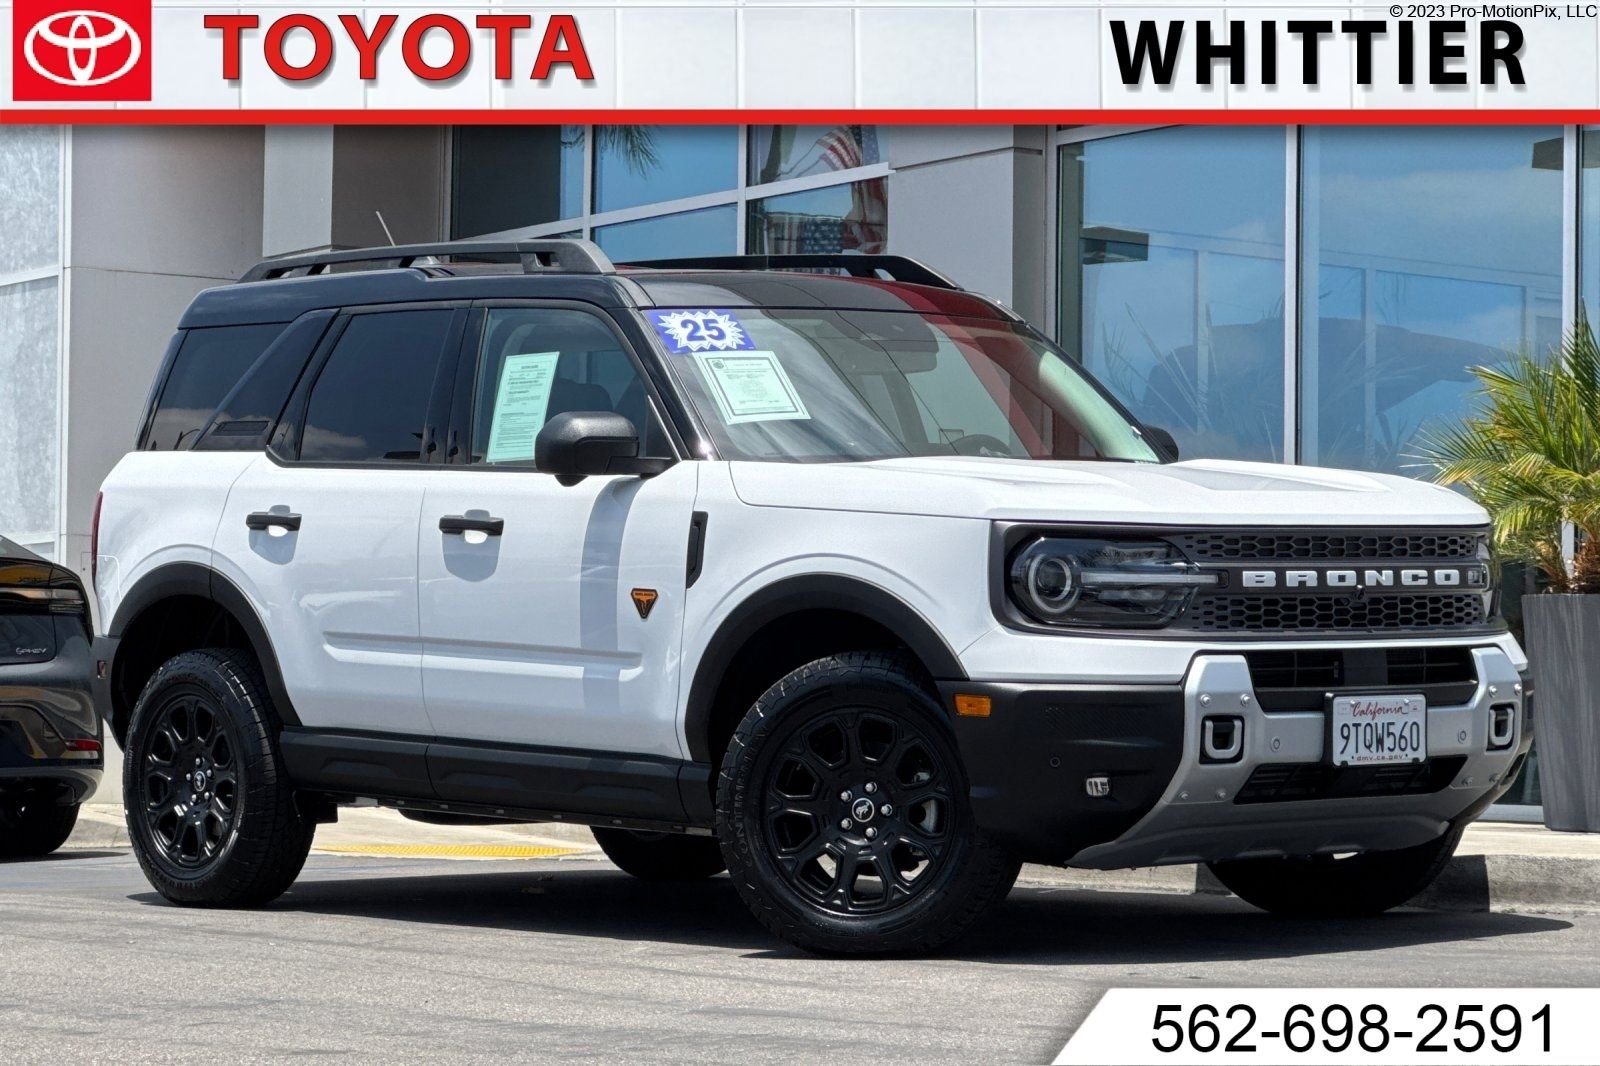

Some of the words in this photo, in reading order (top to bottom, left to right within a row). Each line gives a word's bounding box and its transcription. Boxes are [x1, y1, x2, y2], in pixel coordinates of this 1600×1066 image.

[680, 318, 726, 342] 25
[1242, 569, 1459, 587] BRONCO
[1351, 702, 1408, 720] California
[1339, 721, 1421, 755] 9TQW560
